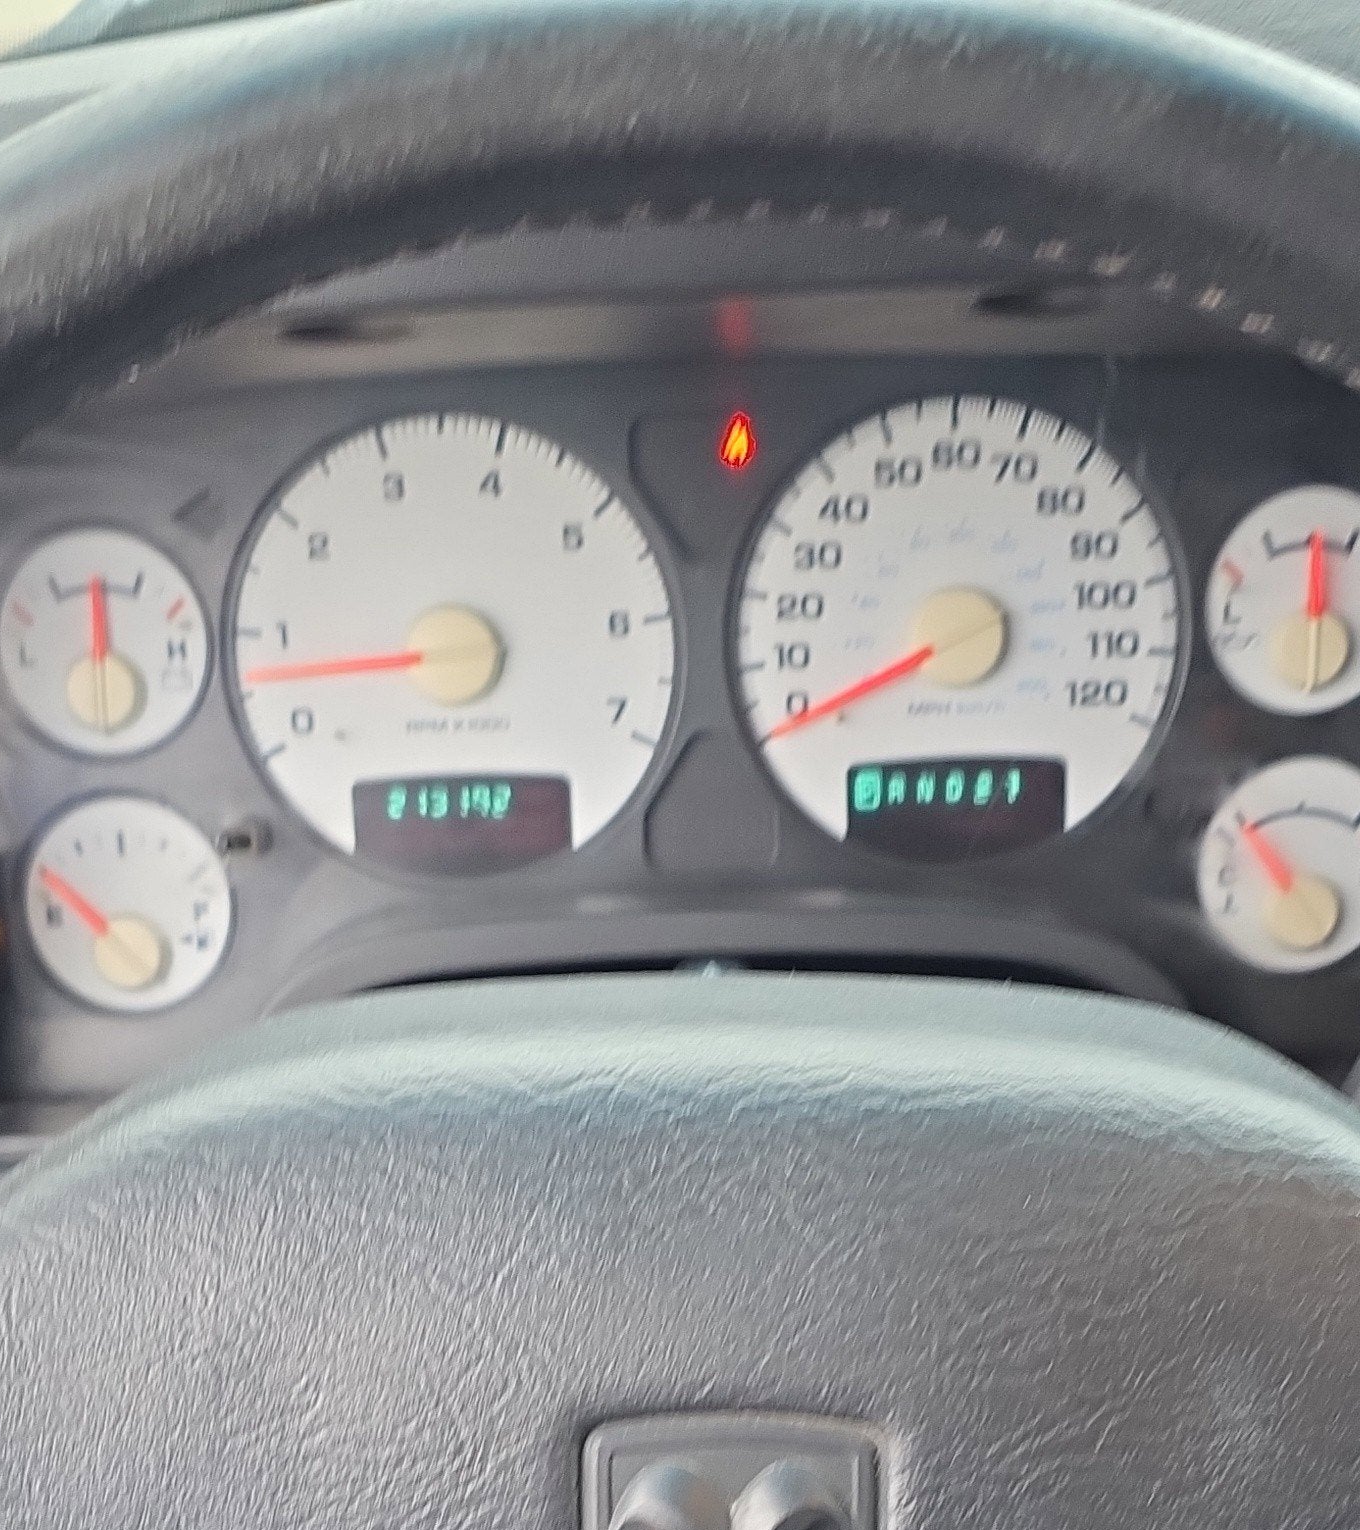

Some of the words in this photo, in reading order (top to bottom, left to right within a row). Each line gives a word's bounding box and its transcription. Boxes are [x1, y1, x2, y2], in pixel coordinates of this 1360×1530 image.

[931, 438, 981, 470] 60
[993, 453, 1040, 483] 70
[381, 470, 405, 503] 3
[477, 468, 505, 500] 4
[874, 457, 924, 489] 50
[819, 494, 870, 524] 40
[1035, 485, 1086, 516] 80
[306, 531, 332, 562] 2
[562, 520, 585, 553] 5
[1069, 531, 1119, 561] 90
[793, 542, 843, 570] 30
[776, 592, 824, 621] 20
[1074, 580, 1137, 610] 100
[275, 620, 289, 650] 1
[607, 608, 631, 638] 6
[773, 642, 810, 671] 10
[1087, 630, 1140, 659] 110
[786, 692, 809, 717] 0
[1065, 679, 1128, 708] 120
[290, 706, 315, 736] 0
[605, 696, 629, 727] 7
